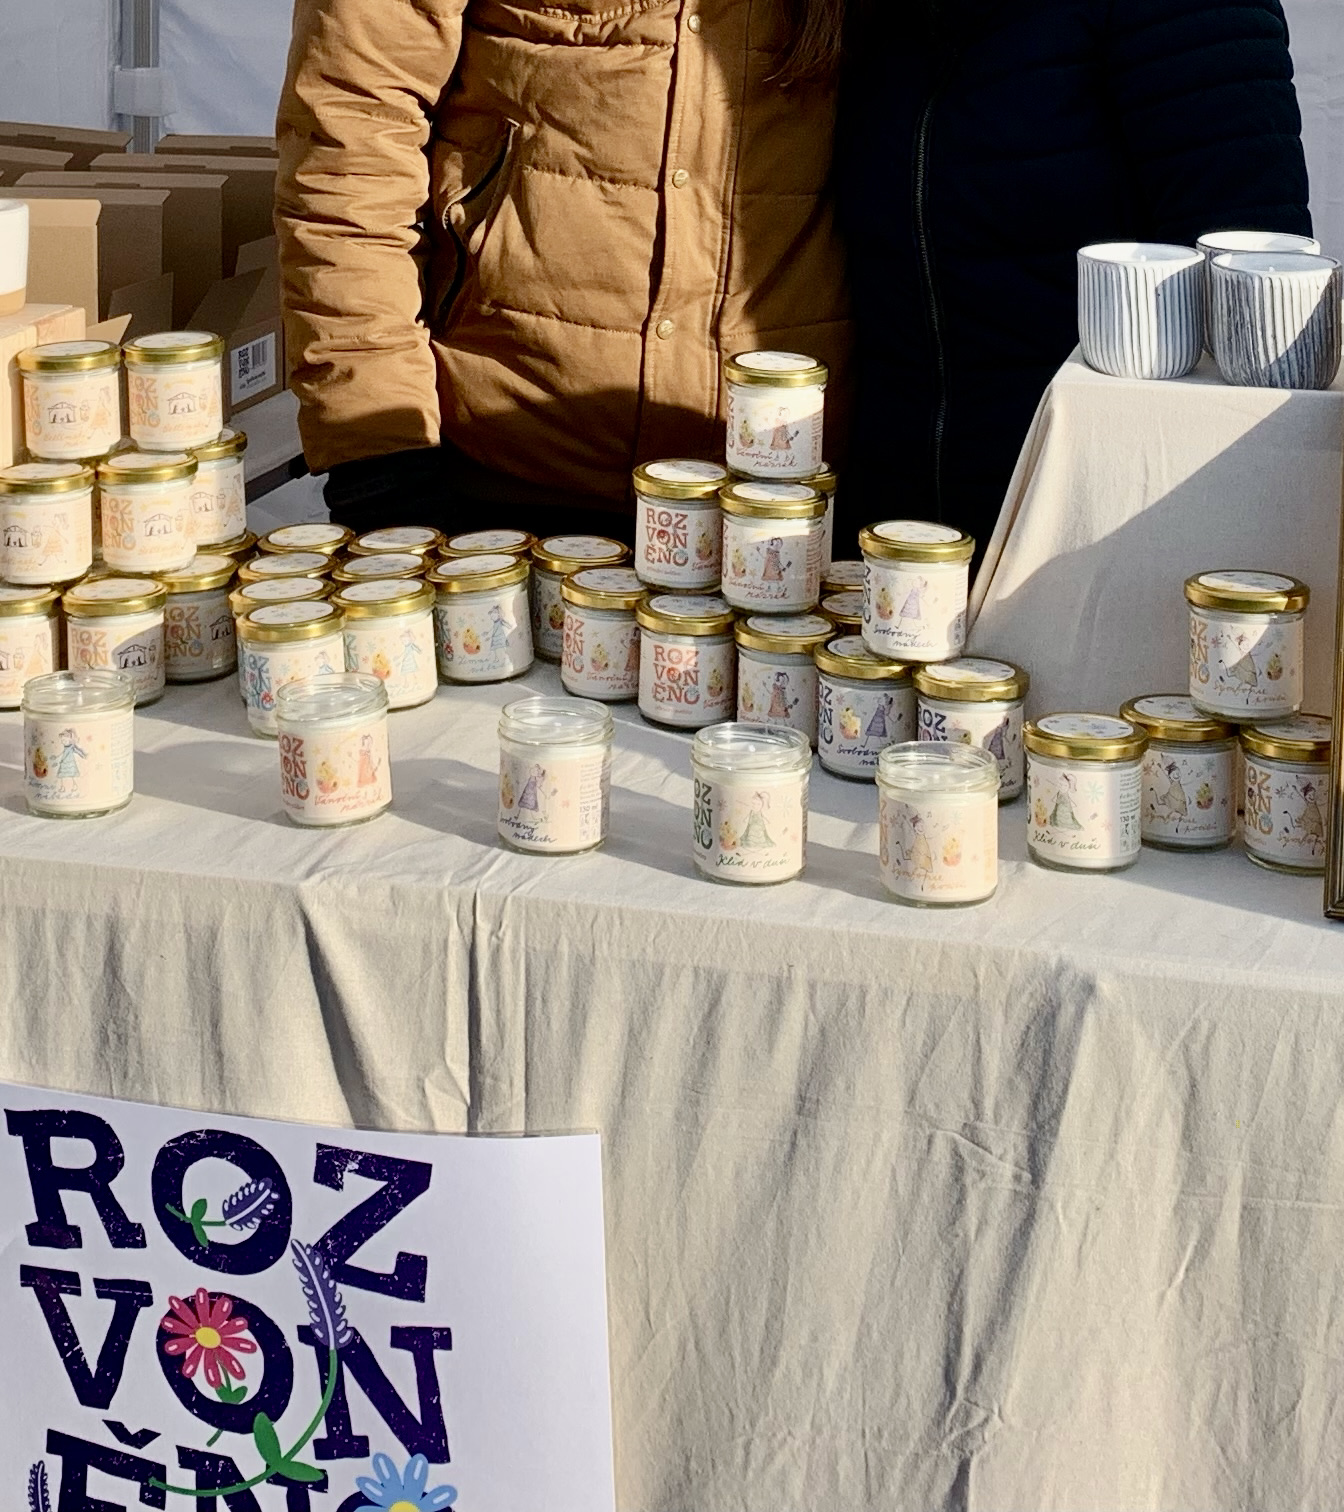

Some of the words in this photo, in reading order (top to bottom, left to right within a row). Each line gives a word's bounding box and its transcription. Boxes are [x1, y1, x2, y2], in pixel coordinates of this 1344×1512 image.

[646, 507, 689, 531] ROZ
[646, 525, 689, 550] VON
[565, 615, 585, 638] OZ
[565, 632, 585, 656] ON
[653, 644, 700, 668] ROZ
[652, 663, 700, 686] VON
[818, 682, 833, 705] OZ
[279, 733, 305, 757] OZ
[836, 744, 879, 757] Svobodn
[280, 756, 308, 779] ON
[1247, 766, 1271, 790] OZ
[281, 778, 310, 801] NO
[693, 778, 712, 806] OZ
[693, 805, 712, 827] ON
[4, 1108, 433, 1303] ROZ
[19, 1264, 453, 1464] VON
